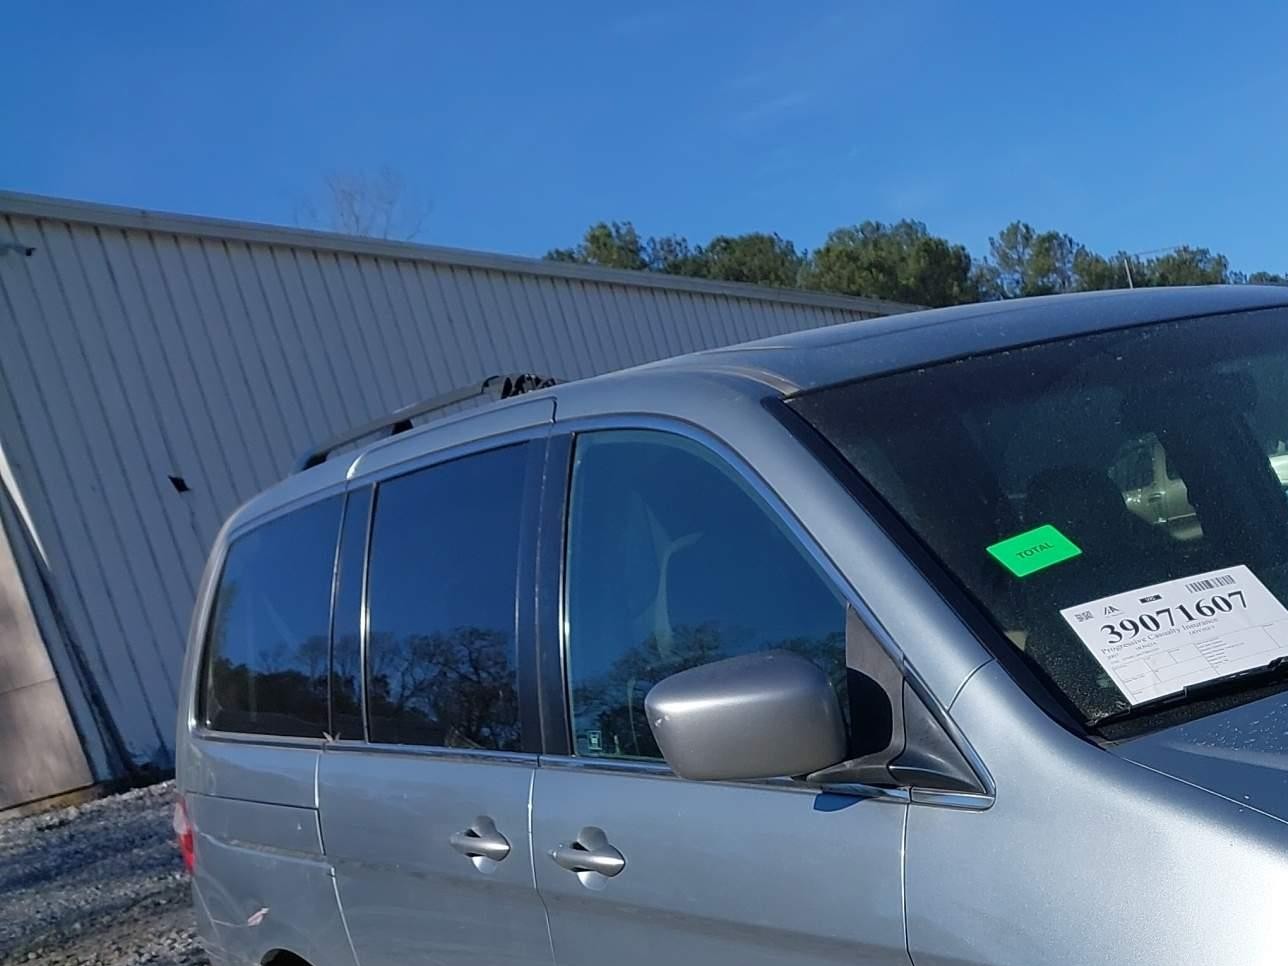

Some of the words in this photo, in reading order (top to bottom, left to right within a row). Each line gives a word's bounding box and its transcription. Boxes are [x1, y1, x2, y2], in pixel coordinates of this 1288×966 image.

[1016, 542, 1055, 558] TOTAL
[1100, 590, 1247, 644] 39071607
[1101, 637, 1148, 655] Progressive
[1147, 626, 1181, 642] Casualty
[1181, 618, 1218, 632] Insurance
